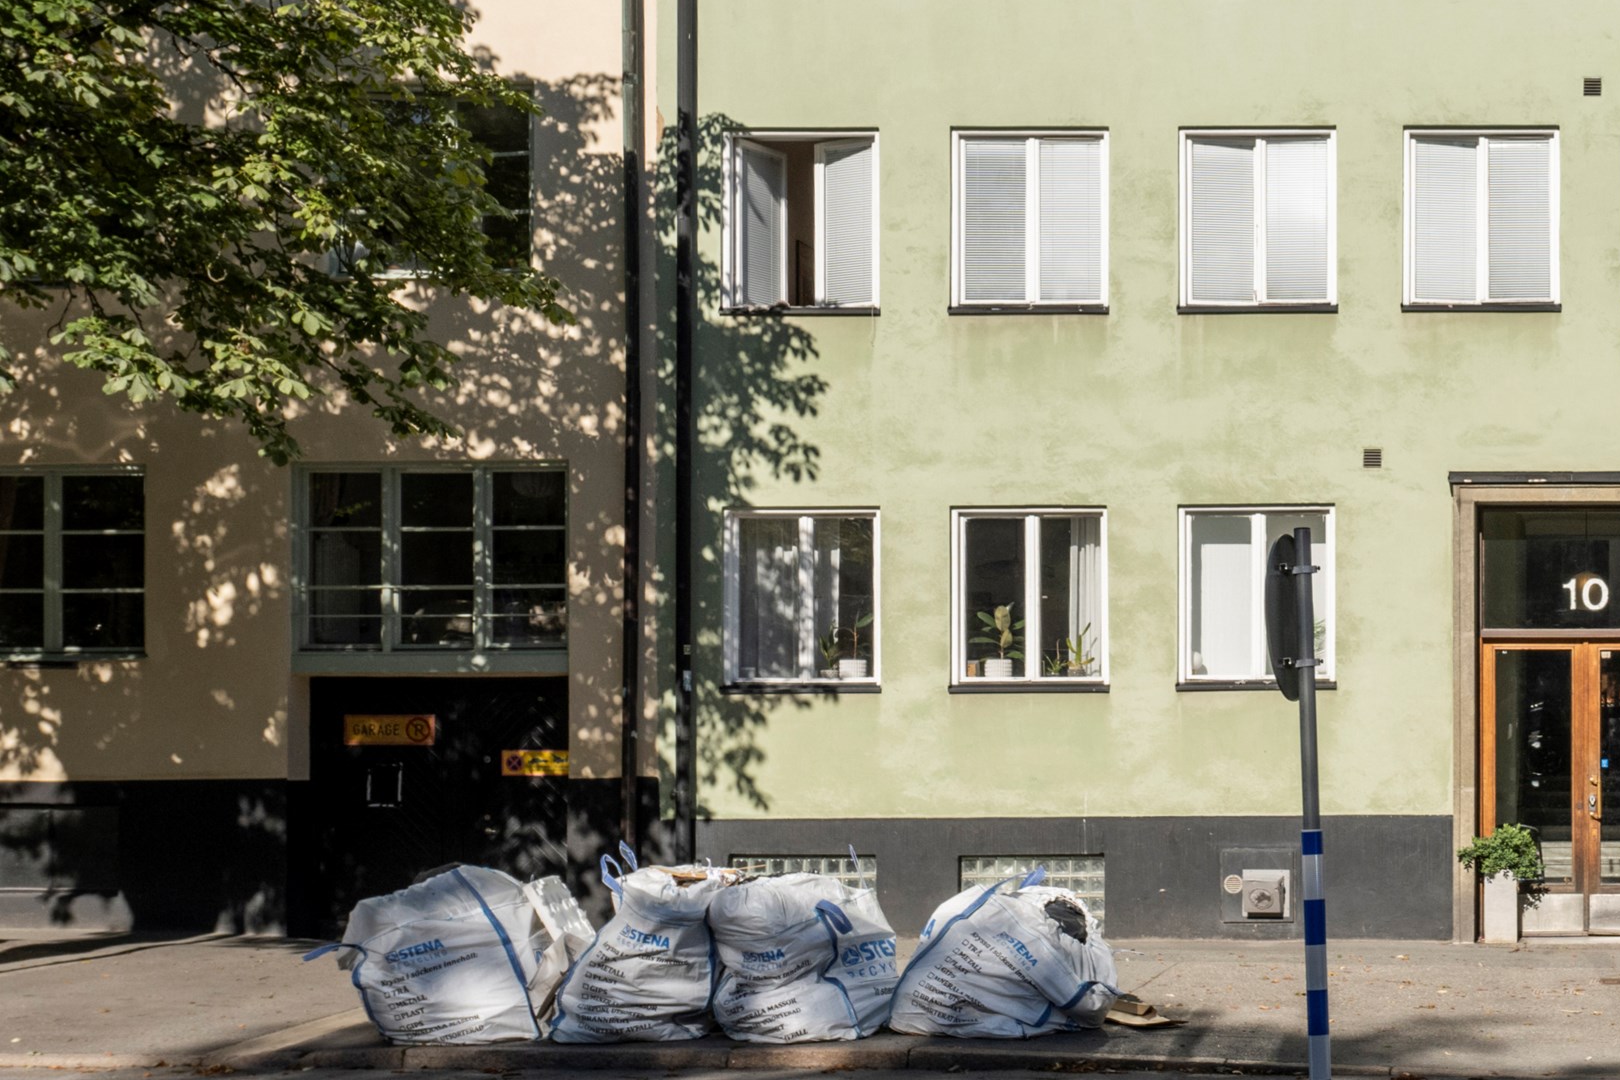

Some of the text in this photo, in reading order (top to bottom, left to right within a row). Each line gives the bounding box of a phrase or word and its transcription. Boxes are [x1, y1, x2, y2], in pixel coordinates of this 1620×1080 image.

[1562, 578, 1609, 611] 10
[352, 724, 399, 736] GARAGE
[629, 929, 670, 949] STENA
[398, 939, 444, 961] STENA
[1007, 936, 1038, 967] STENA
[597, 962, 626, 978] METALL
[959, 951, 983, 974] METALL
[592, 974, 619, 984] PLAST
[589, 986, 608, 995] GIPS
[766, 997, 797, 1012] MASSOR
[400, 1007, 425, 1020] PLAST
[406, 1021, 425, 1031] GIPS
